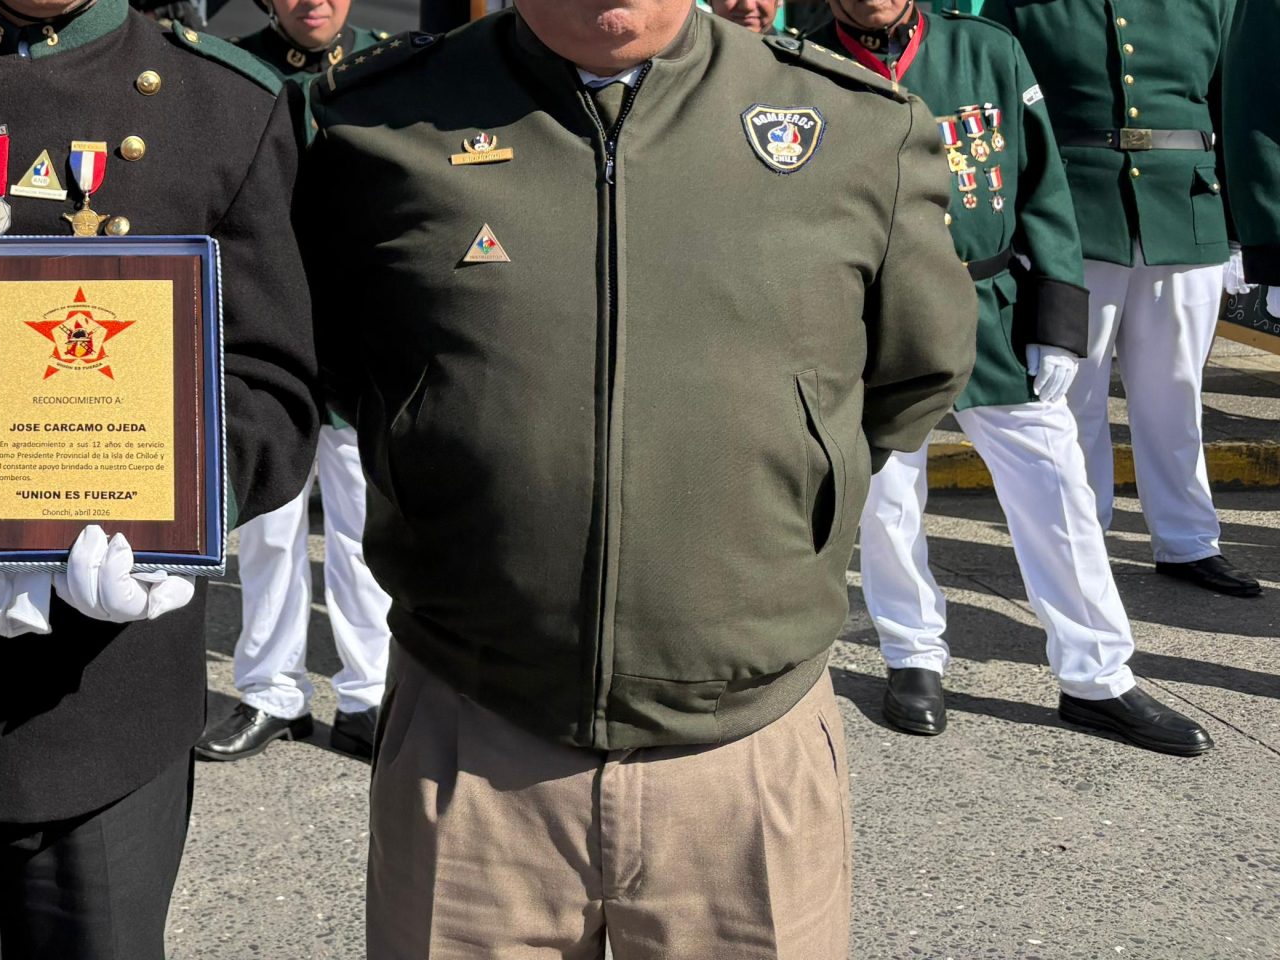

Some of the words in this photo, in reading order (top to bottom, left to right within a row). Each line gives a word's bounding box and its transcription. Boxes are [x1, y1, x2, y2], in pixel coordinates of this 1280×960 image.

[42, 25, 58, 46] 3
[752, 113, 814, 129] BOMBEROS
[773, 154, 798, 163] CHILE
[32, 396, 112, 404] RECONOCIMIENTO
[115, 396, 124, 404] A:
[10, 423, 40, 432] JOSE
[44, 423, 103, 432] CARCAMO
[107, 423, 146, 432] OJEDA
[12, 441, 65, 449] agradecimiento
[65, 490, 80, 499] ES
[42, 509, 73, 517] Chonchi,
